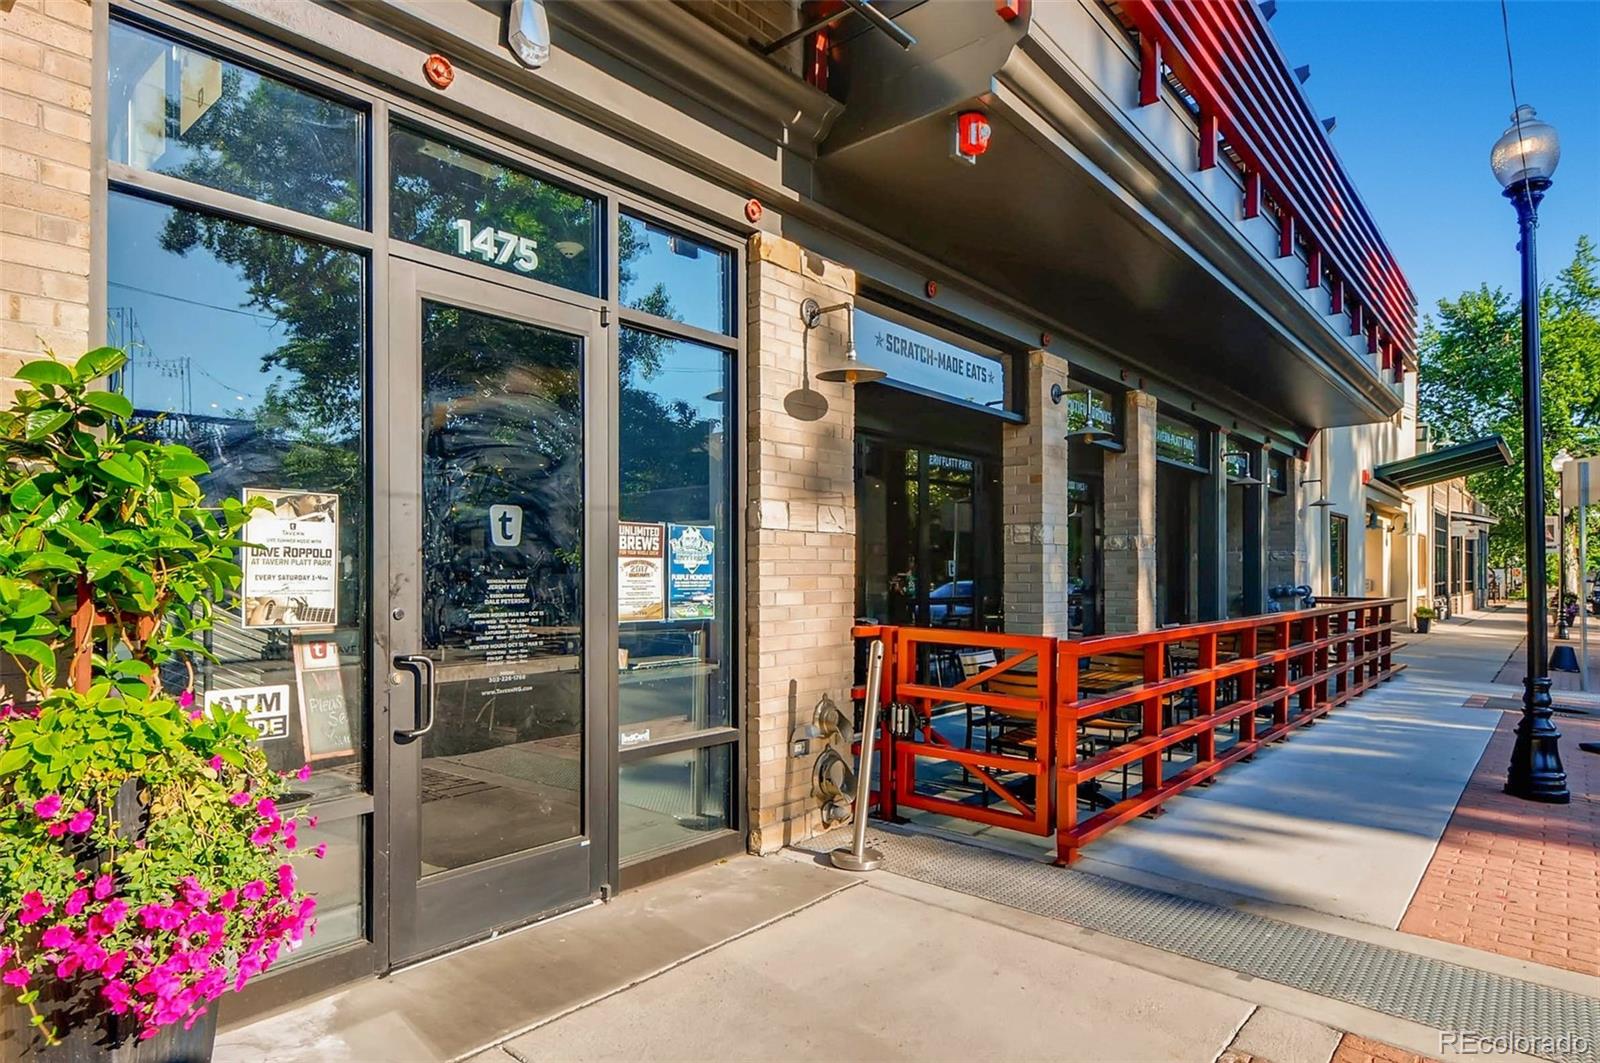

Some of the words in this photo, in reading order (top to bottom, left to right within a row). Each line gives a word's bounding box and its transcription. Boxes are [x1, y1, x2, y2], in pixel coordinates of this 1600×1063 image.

[453, 219, 538, 272] 1475
[886, 334, 964, 376] SCRATCH-MADE
[966, 361, 987, 382] EATS
[498, 511, 513, 540] t
[619, 525, 660, 537] UNLIMITED
[251, 547, 280, 557] DAVE
[283, 546, 332, 558] ROPPOLO
[619, 536, 660, 551] BREWS
[262, 558, 290, 566] TAVERN
[314, 559, 332, 567] PARK
[214, 692, 281, 712] ATM
